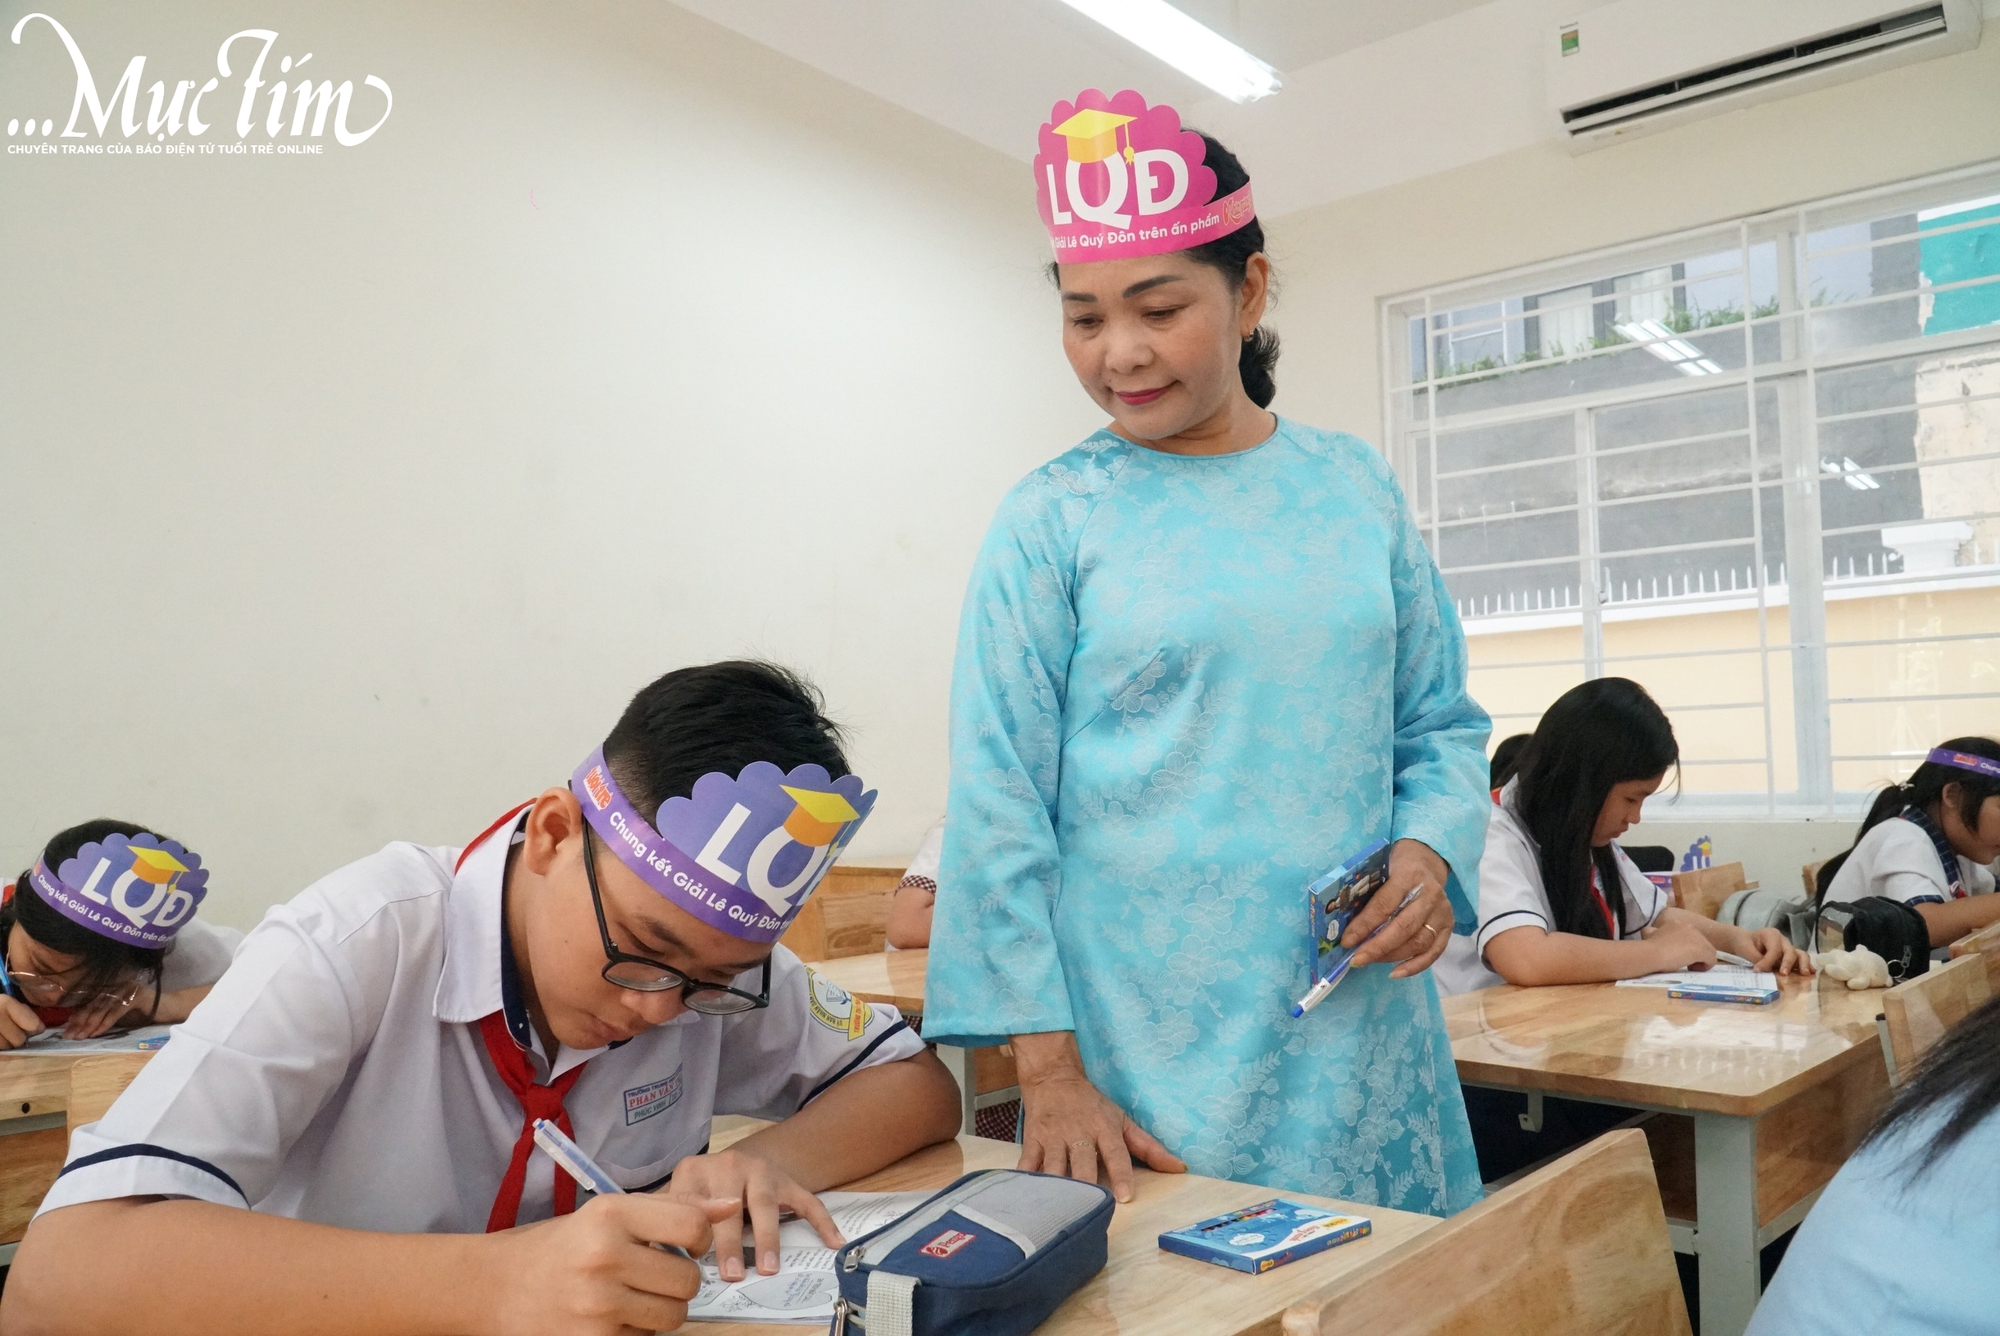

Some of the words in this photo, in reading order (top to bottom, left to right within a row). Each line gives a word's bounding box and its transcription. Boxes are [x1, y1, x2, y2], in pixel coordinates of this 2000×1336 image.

[1046, 149, 1189, 230] LQĐ
[1067, 235, 1078, 249] Lê
[1079, 232, 1104, 249] Quý
[1107, 229, 1136, 245] Đôn
[1138, 225, 1168, 241] trên
[1170, 220, 1188, 236] ấn
[1190, 212, 1220, 235] phẩm
[80, 857, 194, 930] LQĐ
[609, 811, 648, 858] Chung
[646, 849, 673, 878] kết
[673, 871, 709, 901] Giải
[705, 892, 728, 912] Lê
[727, 904, 759, 927] Quý
[757, 915, 782, 931] Đôn
[37, 874, 56, 897] Chung
[68, 899, 89, 916] Giải
[87, 909, 101, 922] Lê
[101, 916, 123, 932] Quý
[122, 925, 142, 938] Đôn
[629, 1092, 656, 1108] PHAN
